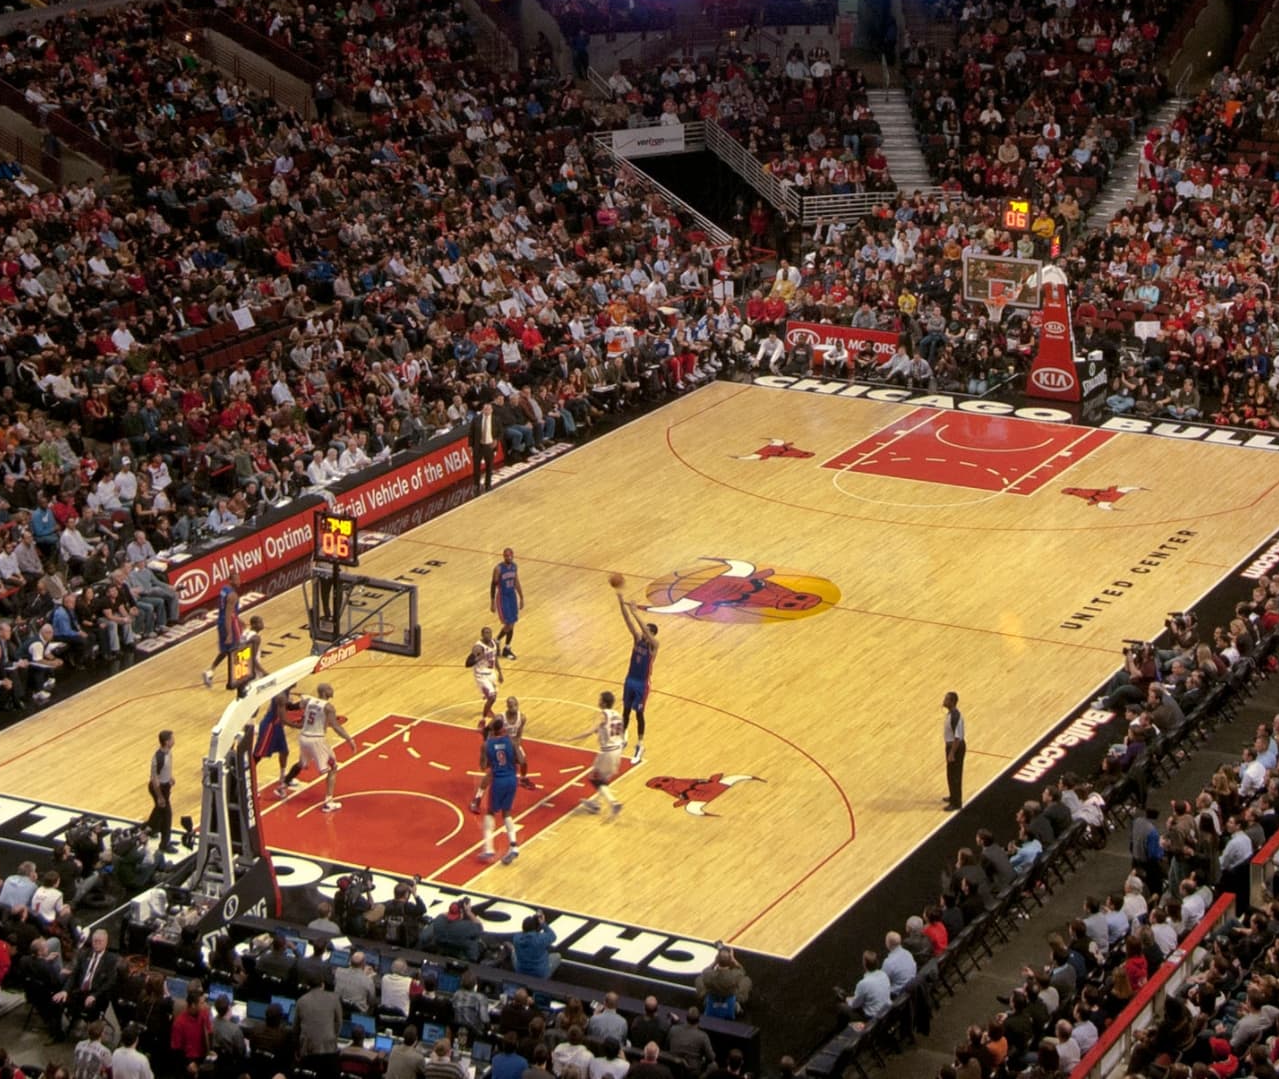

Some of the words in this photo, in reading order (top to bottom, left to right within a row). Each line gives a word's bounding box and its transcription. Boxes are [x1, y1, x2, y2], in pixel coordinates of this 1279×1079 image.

[1006, 211, 1026, 228] 06
[751, 375, 1073, 422] CHICAGO
[1039, 372, 1068, 387] KIA
[366, 475, 410, 513] Vehicle
[410, 467, 425, 491] of
[423, 460, 444, 485] the
[443, 446, 471, 474] NBA
[211, 556, 263, 596] All-New
[264, 523, 313, 569] Optima
[322, 532, 349, 558] 06
[1060, 580, 1134, 630] UNITED
[1131, 529, 1198, 575] CENTER
[1012, 708, 1118, 783] Bulls.com
